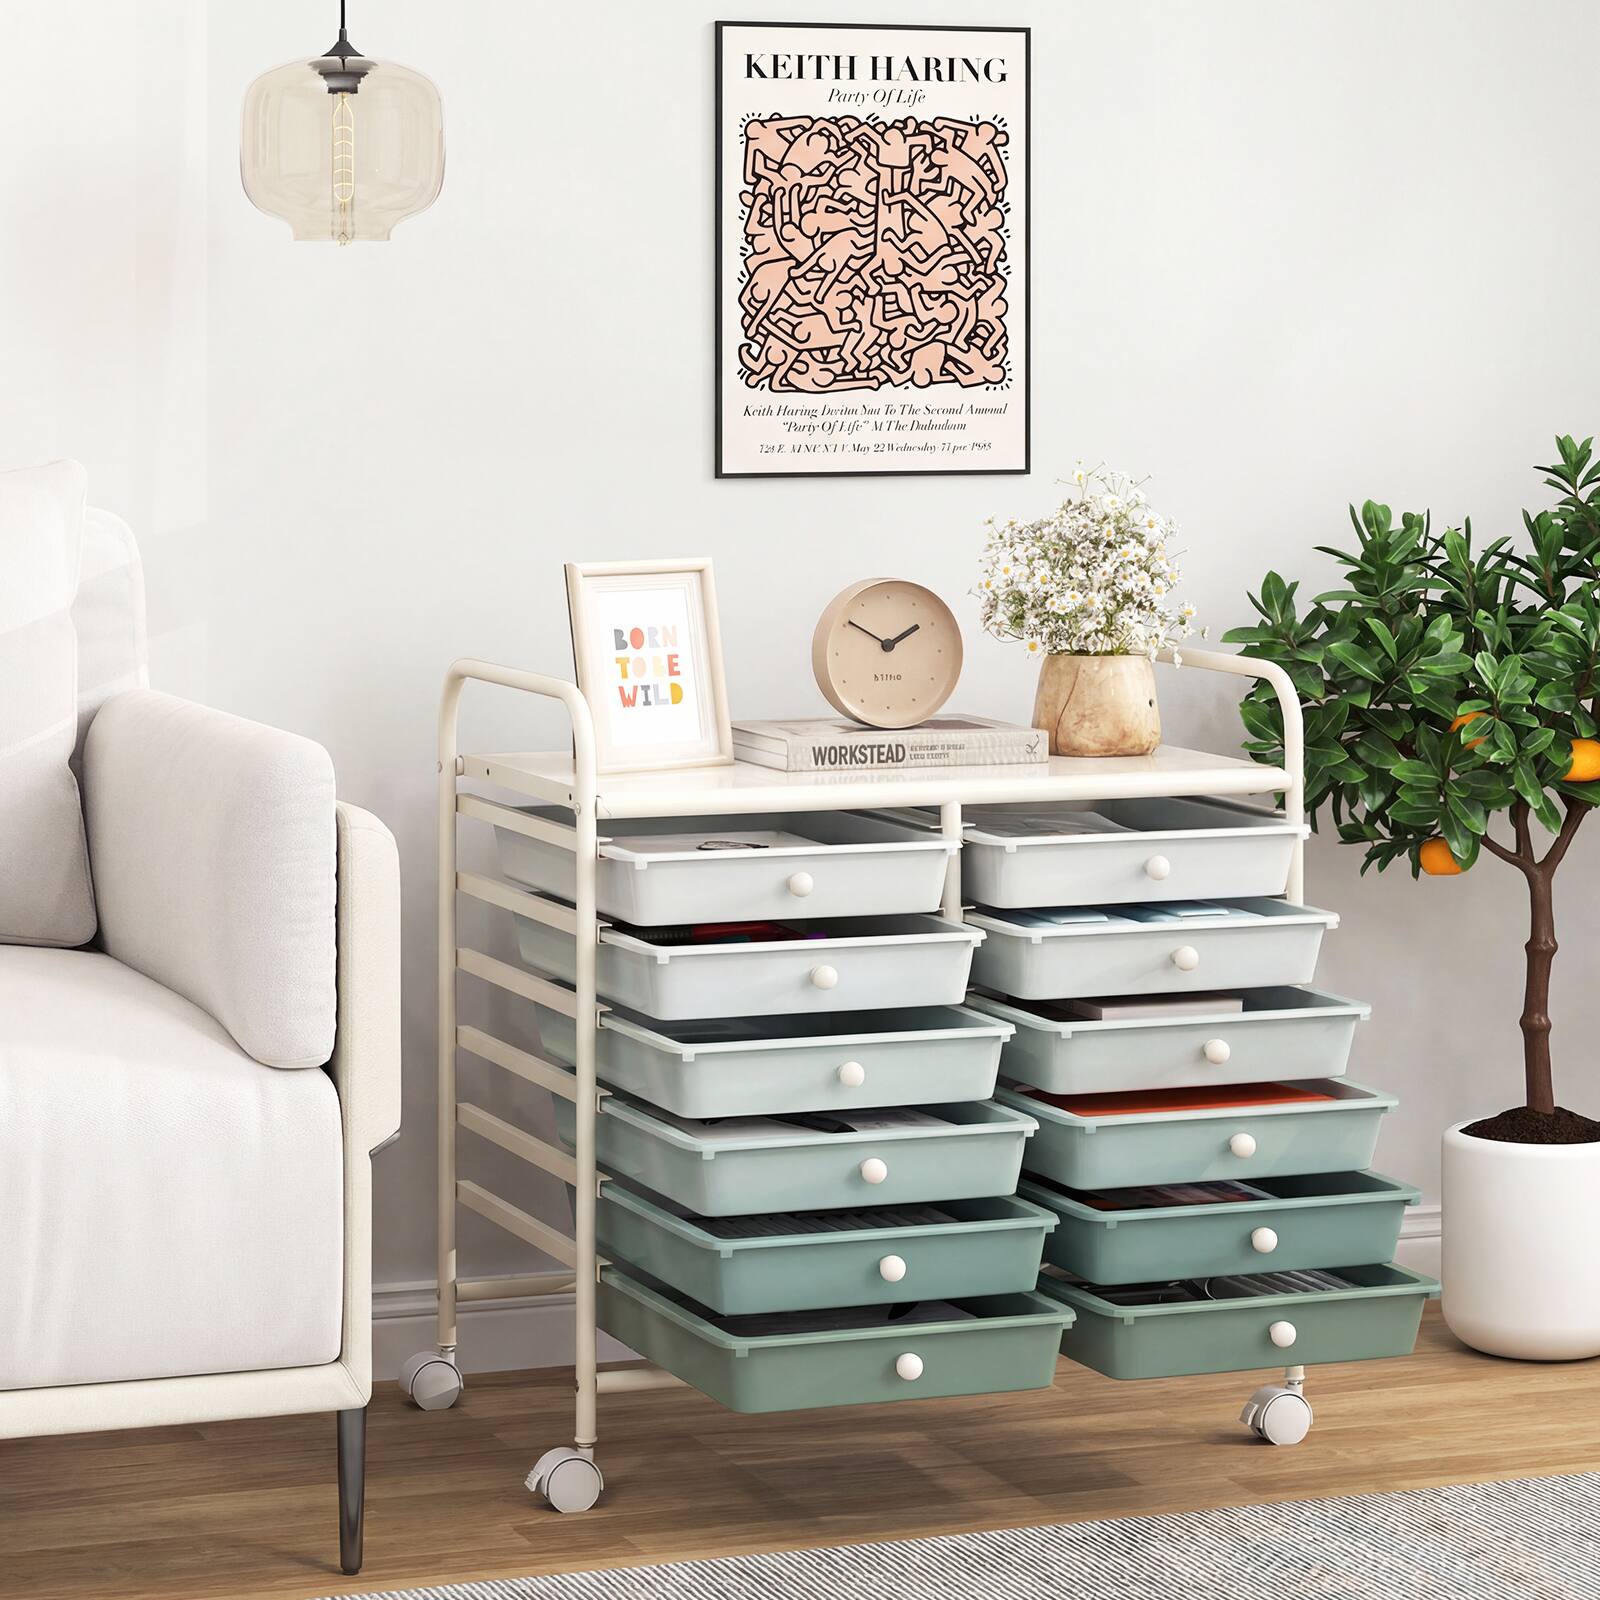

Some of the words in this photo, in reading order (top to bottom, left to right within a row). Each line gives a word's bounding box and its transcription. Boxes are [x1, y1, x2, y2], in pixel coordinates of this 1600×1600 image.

[744, 53, 858, 81] KEITH
[870, 55, 1009, 84] HARING
[828, 87, 869, 107] Party
[873, 87, 897, 108] Of
[896, 88, 926, 107] Life
[743, 404, 773, 417] Keith
[776, 404, 818, 419] Haring
[884, 403, 897, 416] To
[899, 403, 921, 416] The
[923, 403, 964, 416] Second
[821, 419, 838, 436] Of
[885, 419, 908, 432] The
[613, 625, 677, 650] BORN
[618, 682, 684, 708] WILD
[812, 742, 906, 766] WORKSTEAD
